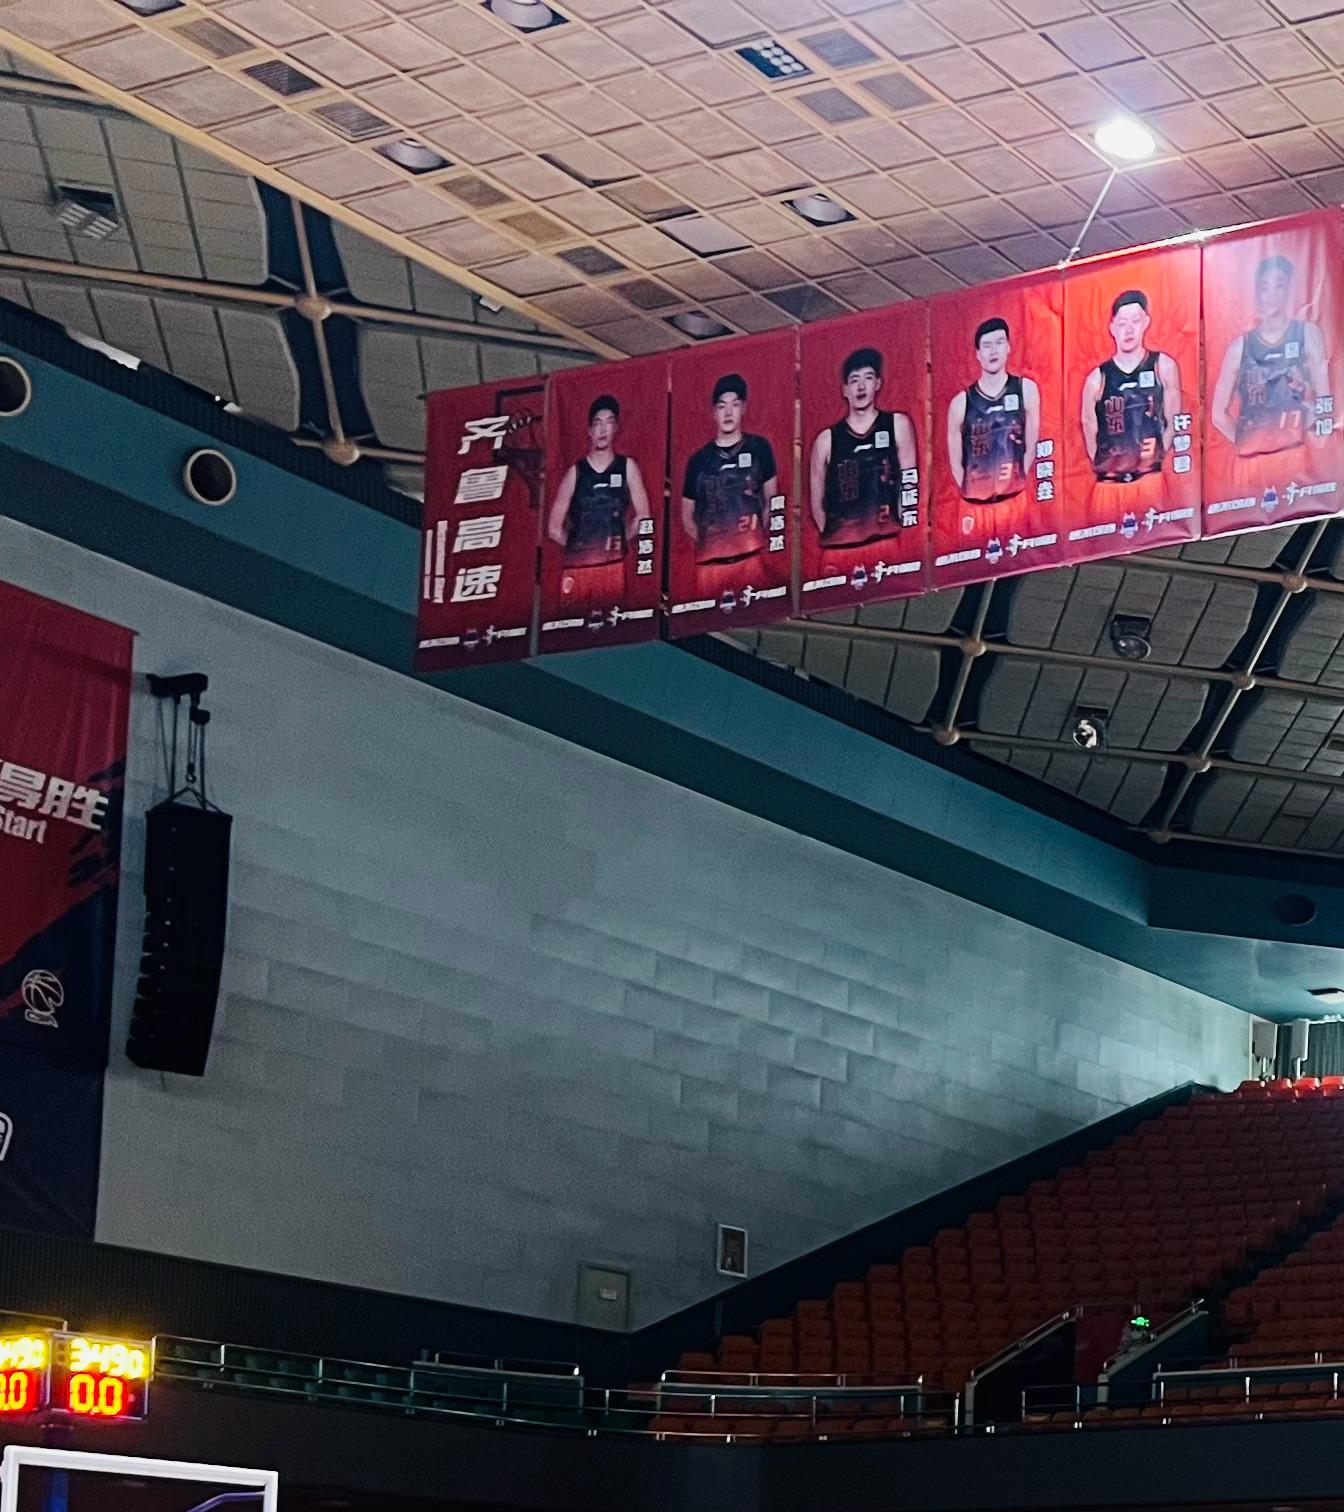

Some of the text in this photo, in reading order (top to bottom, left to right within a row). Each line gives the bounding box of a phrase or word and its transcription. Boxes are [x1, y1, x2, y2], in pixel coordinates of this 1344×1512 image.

[451, 415, 510, 603] 齐鲁高速
[69, 1373, 123, 1415] 0.0
